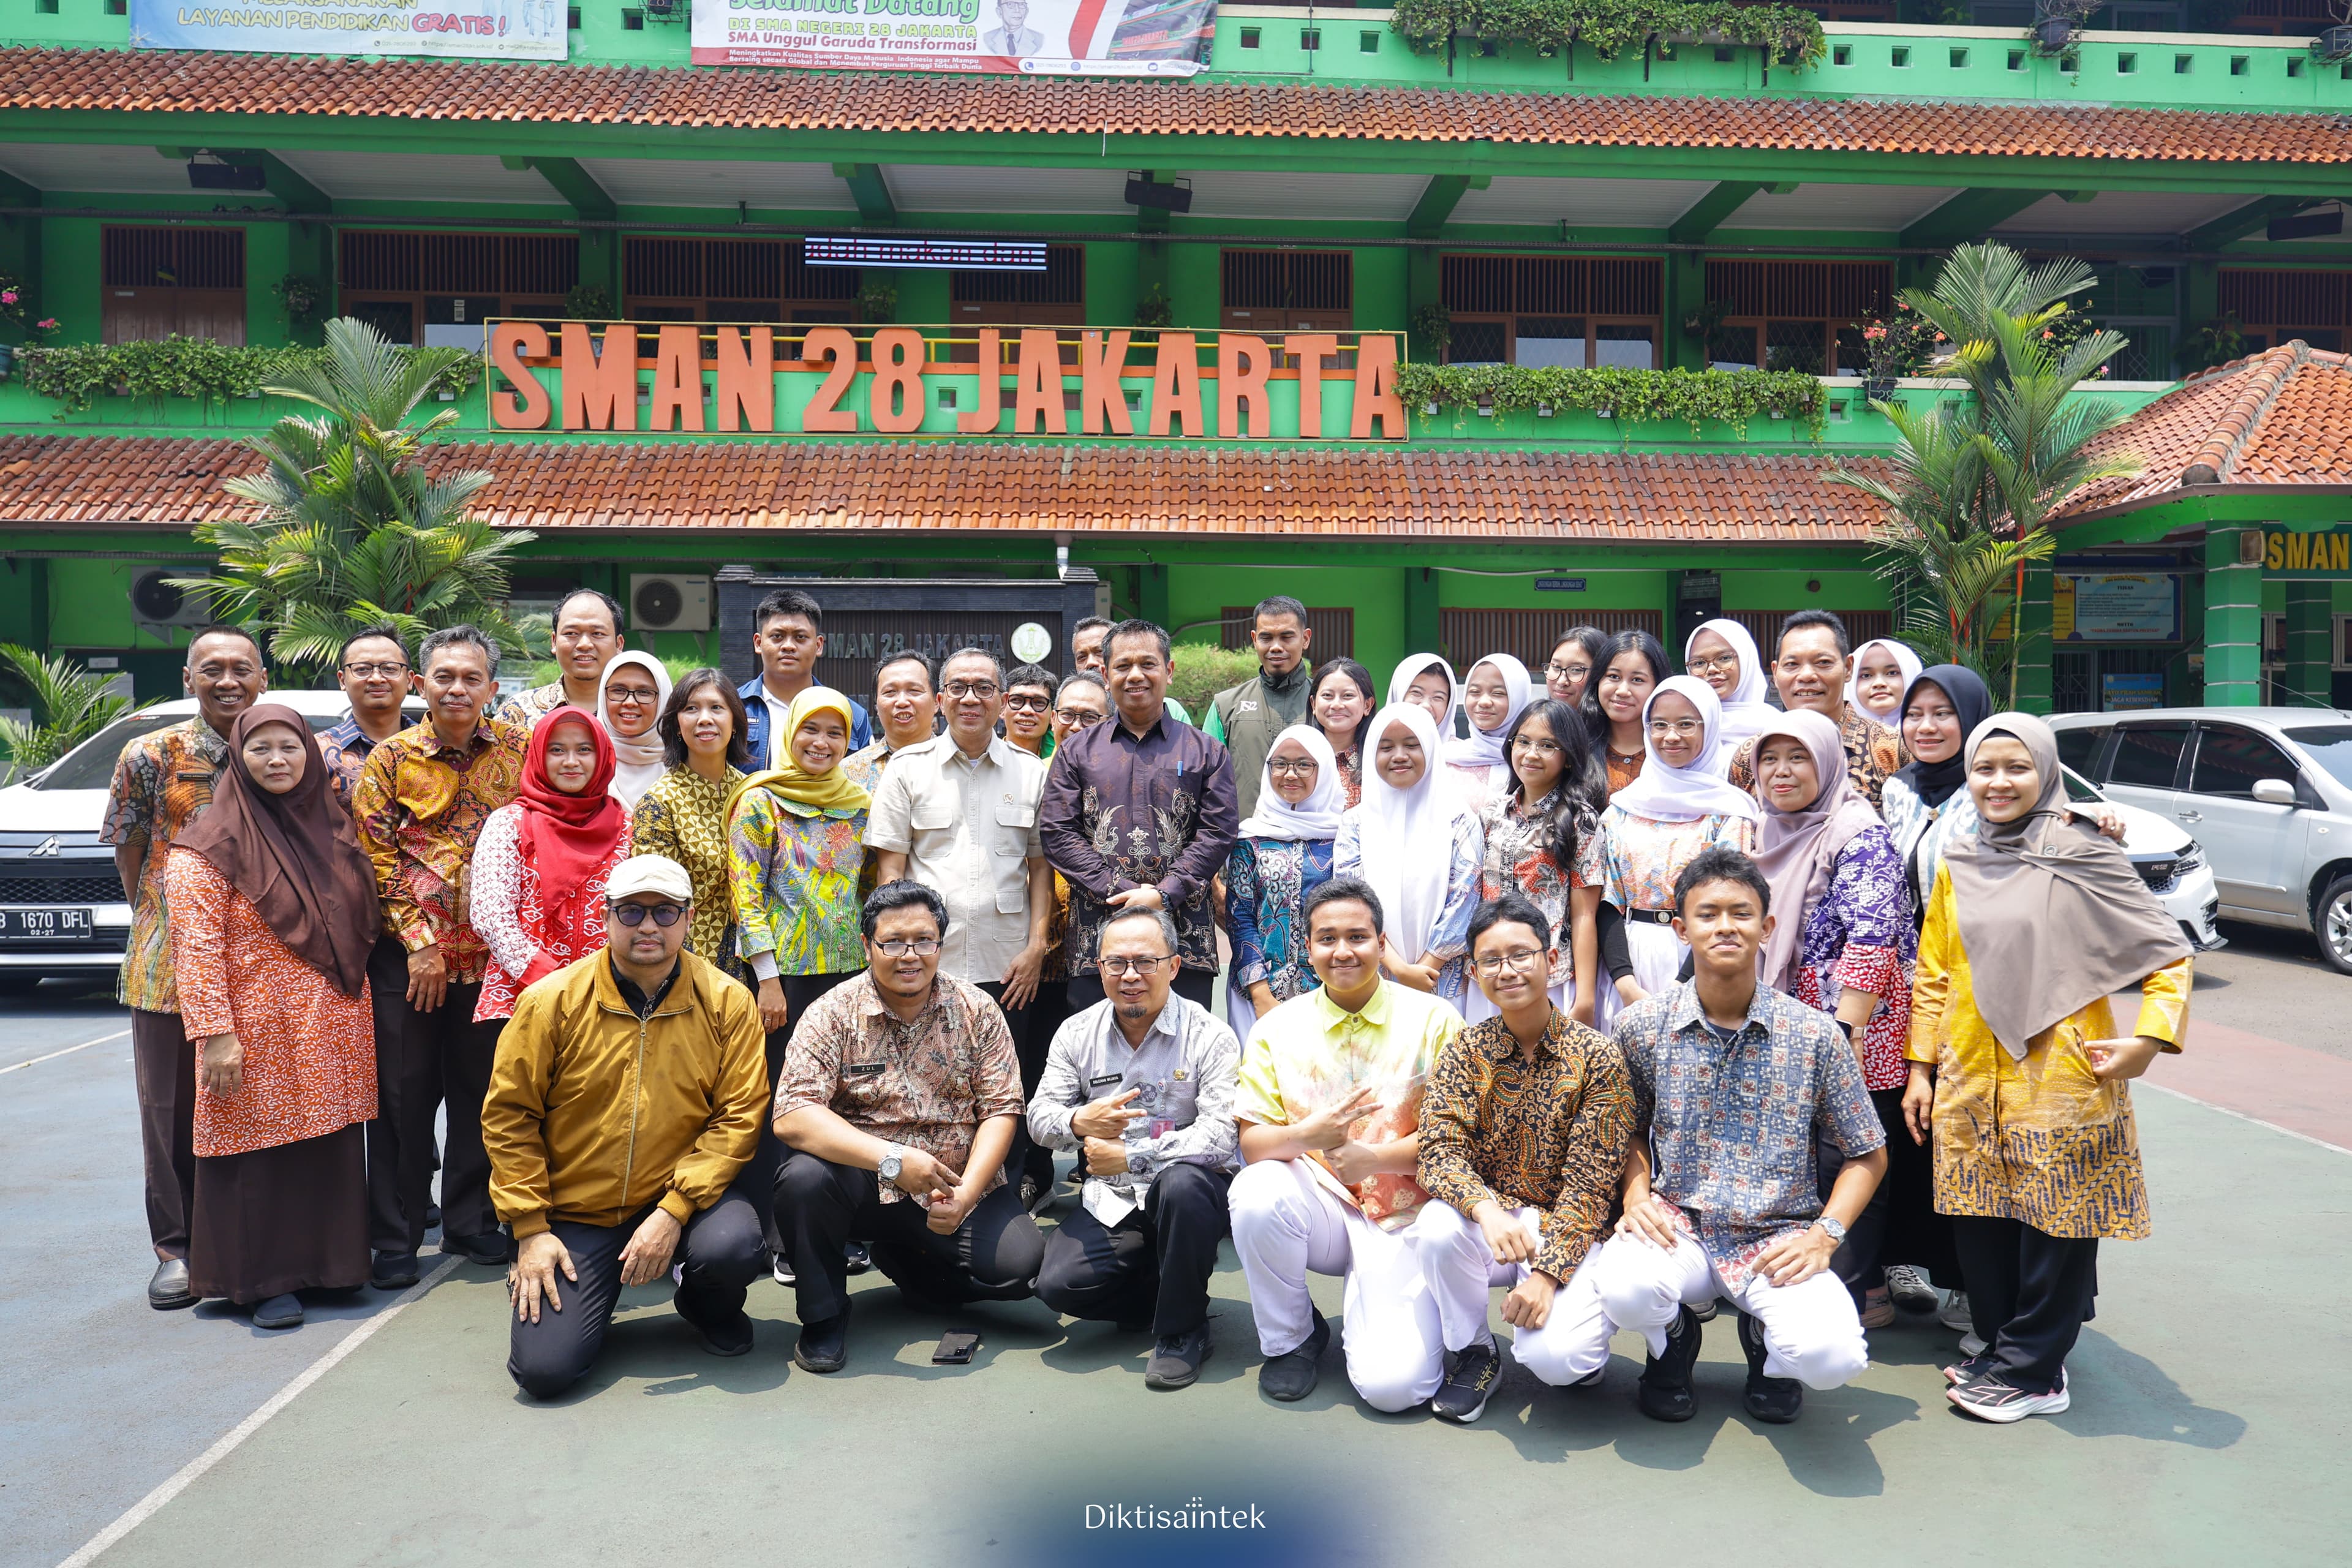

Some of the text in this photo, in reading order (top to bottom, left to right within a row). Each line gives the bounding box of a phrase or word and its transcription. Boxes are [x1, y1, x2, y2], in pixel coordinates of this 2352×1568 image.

[178, 8, 283, 28] LAYANAN
[286, 11, 409, 32] PENDIDIKAN
[728, 17, 978, 38] DI SMA NEGERI 28 JAKARTA
[728, 31, 977, 51] SMA Unggul Garuda Transformasi
[729, 50, 781, 58] Meningkatkan
[783, 51, 812, 59] Kualitas
[844, 54, 862, 62] Daya
[880, 241, 972, 262] makan
[983, 242, 1033, 263] dan
[492, 322, 1405, 439] SMAN 28 JAKARTA
[2267, 532, 2349, 571] SMAN
[819, 633, 1006, 660] MAN 28 JAKARTA
[20, 912, 53, 929] 1670
[62, 911, 88, 929] DFL
